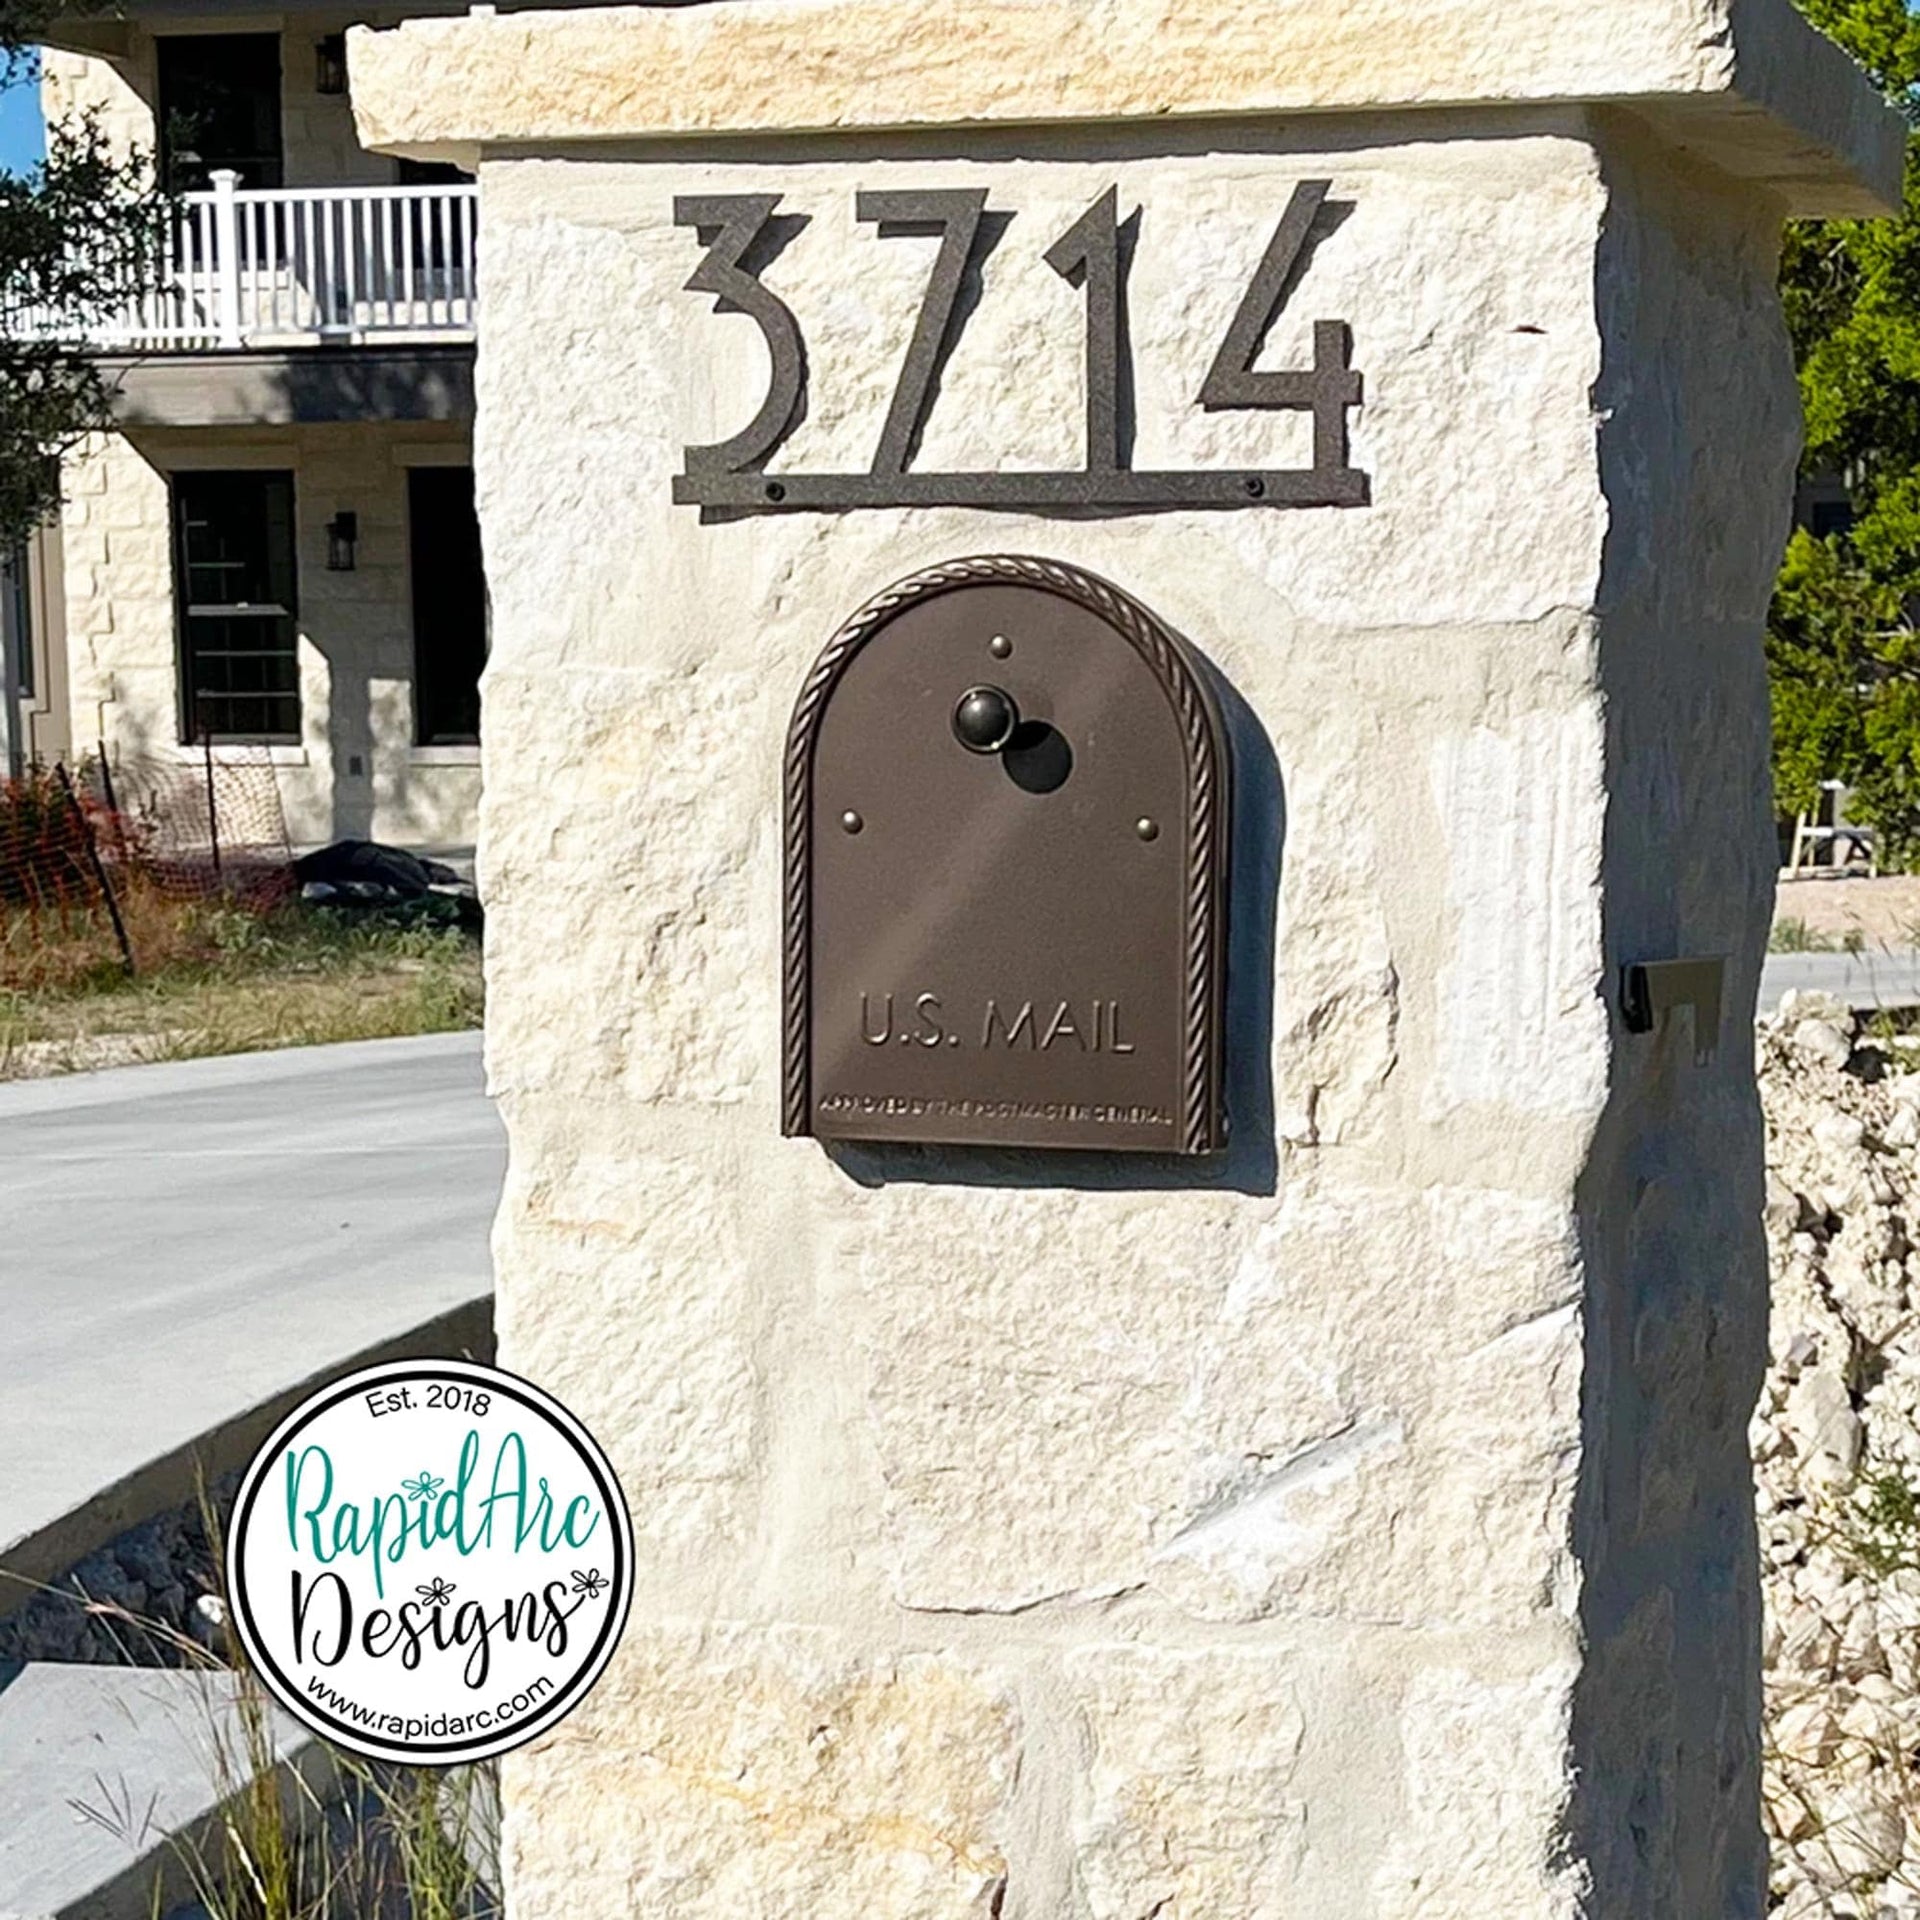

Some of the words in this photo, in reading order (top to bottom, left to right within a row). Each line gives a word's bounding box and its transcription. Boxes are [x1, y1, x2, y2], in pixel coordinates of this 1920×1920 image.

[673, 179, 1368, 503] 3714
[860, 992, 960, 1046] U.S.
[981, 1000, 1135, 1054] MAIL
